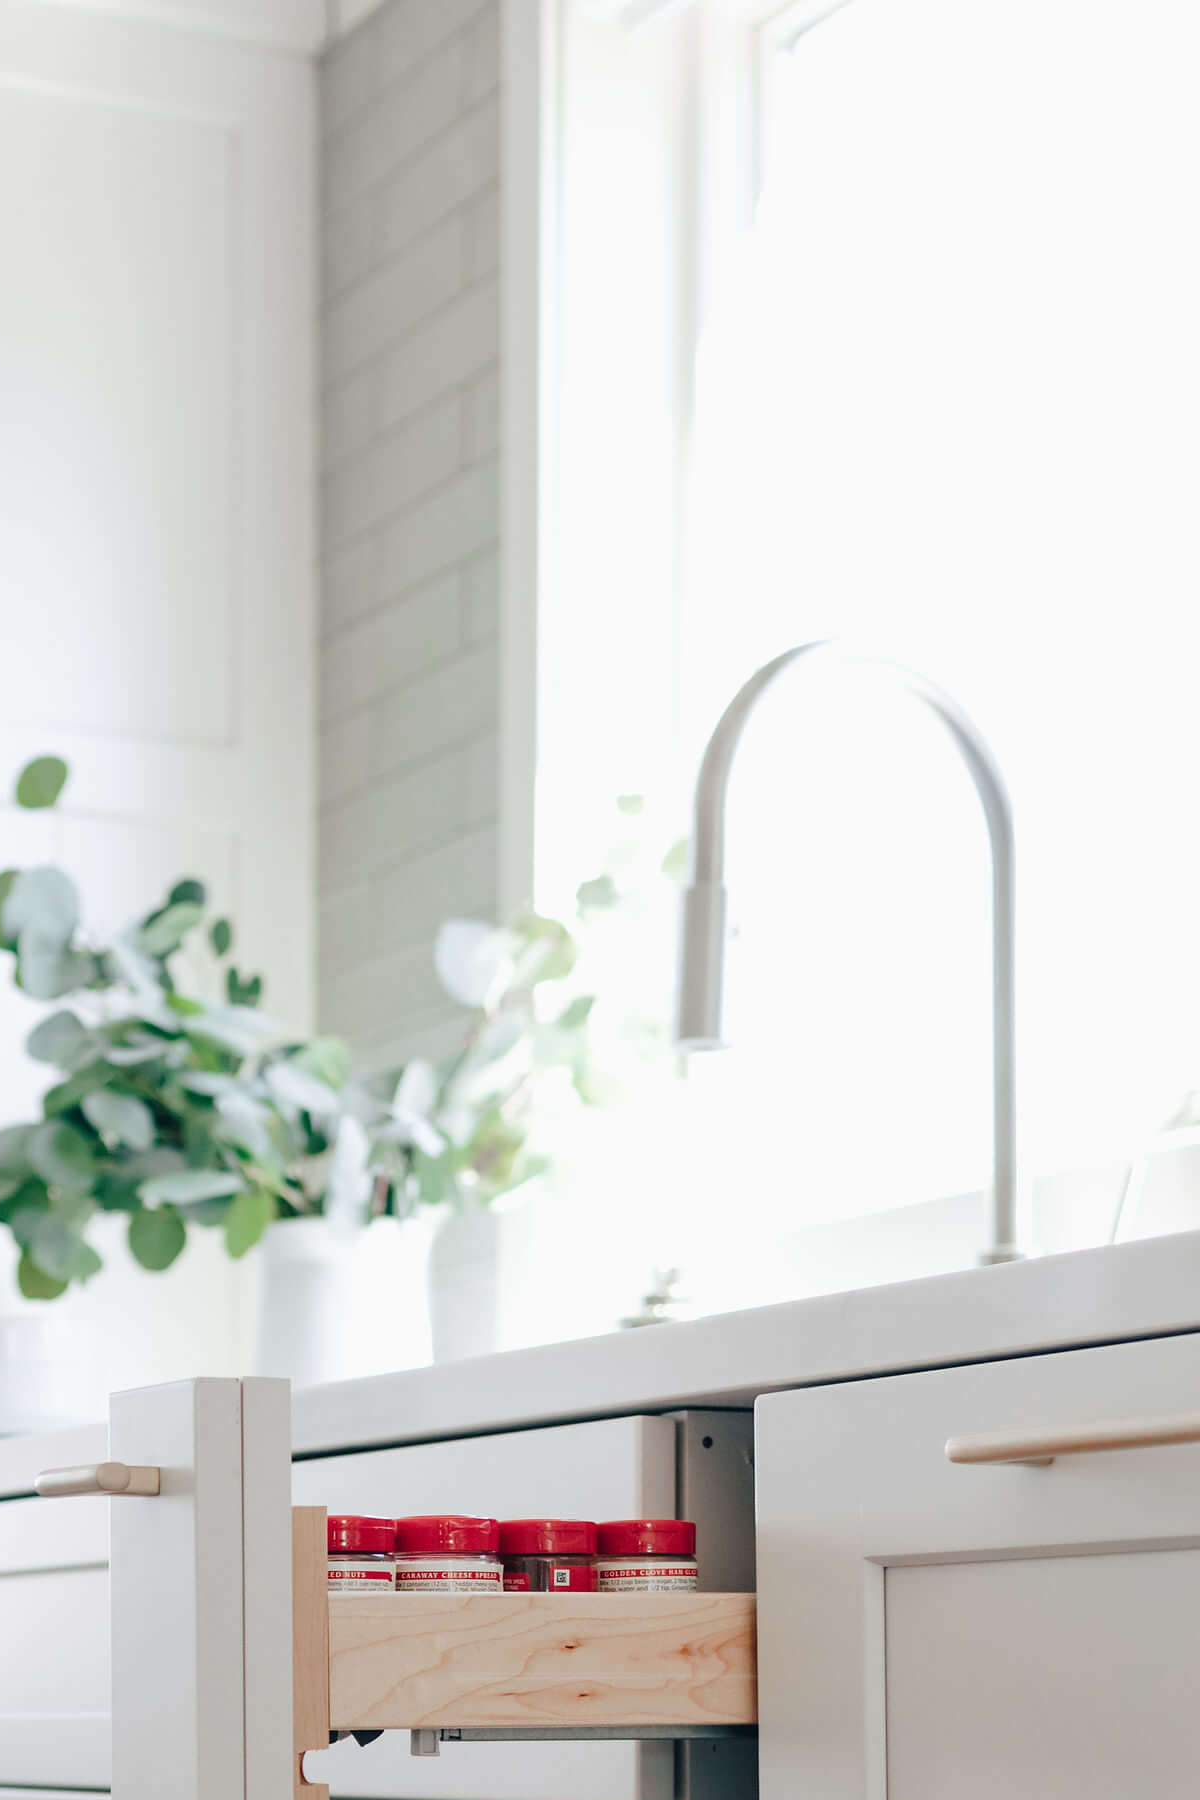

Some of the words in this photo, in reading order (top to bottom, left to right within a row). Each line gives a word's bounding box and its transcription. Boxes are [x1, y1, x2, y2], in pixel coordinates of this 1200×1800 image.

[344, 1571, 366, 1579] NUTS
[401, 1571, 438, 1580] CARAWAY
[441, 1571, 473, 1579] CHEESE
